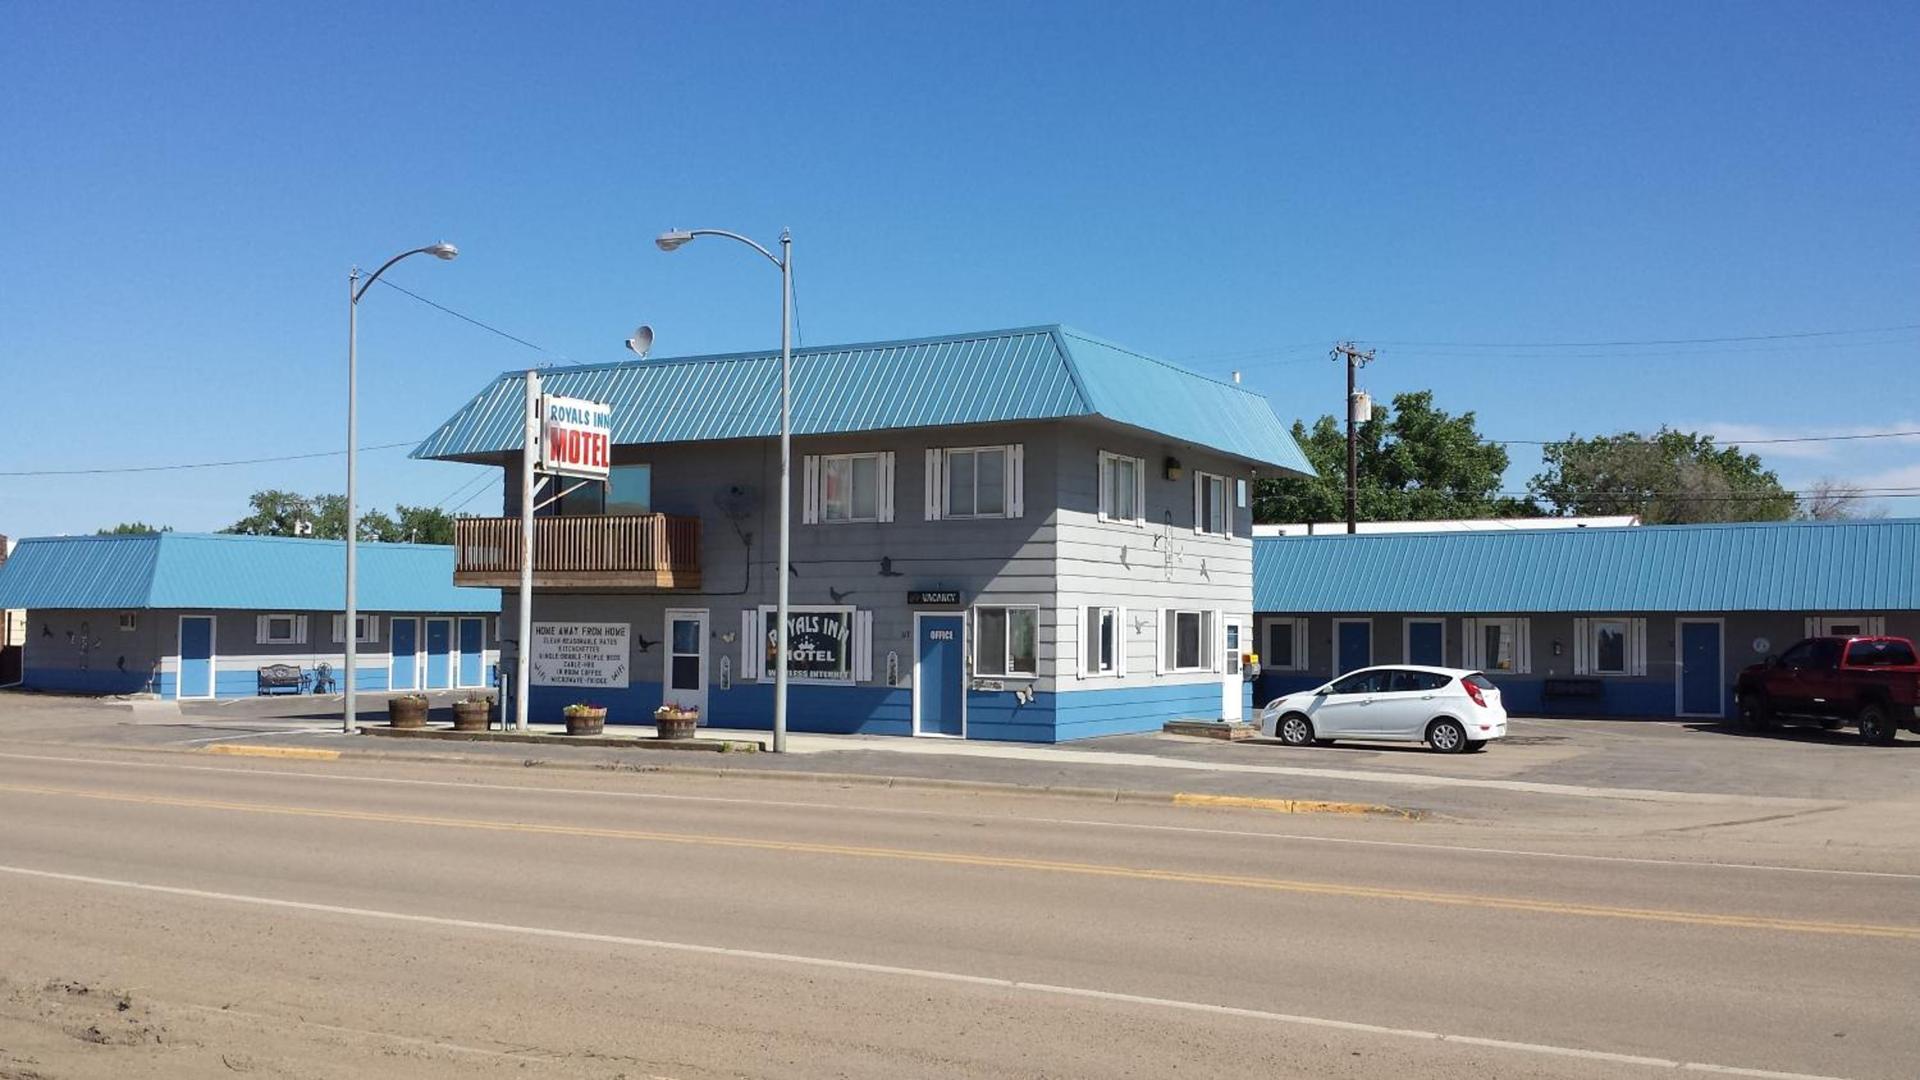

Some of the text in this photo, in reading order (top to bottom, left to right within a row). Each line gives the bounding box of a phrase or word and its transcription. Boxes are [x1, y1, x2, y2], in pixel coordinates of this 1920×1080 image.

[550, 405, 611, 429] ROYALS INN
[550, 427, 609, 468] MOTEL
[922, 592, 956, 603] VACANCY
[535, 626, 626, 637] HOME AWAY FROM HOME
[768, 616, 849, 647] RYALS INN
[930, 630, 953, 640] OFFICE
[809, 670, 849, 679] INTERNET
